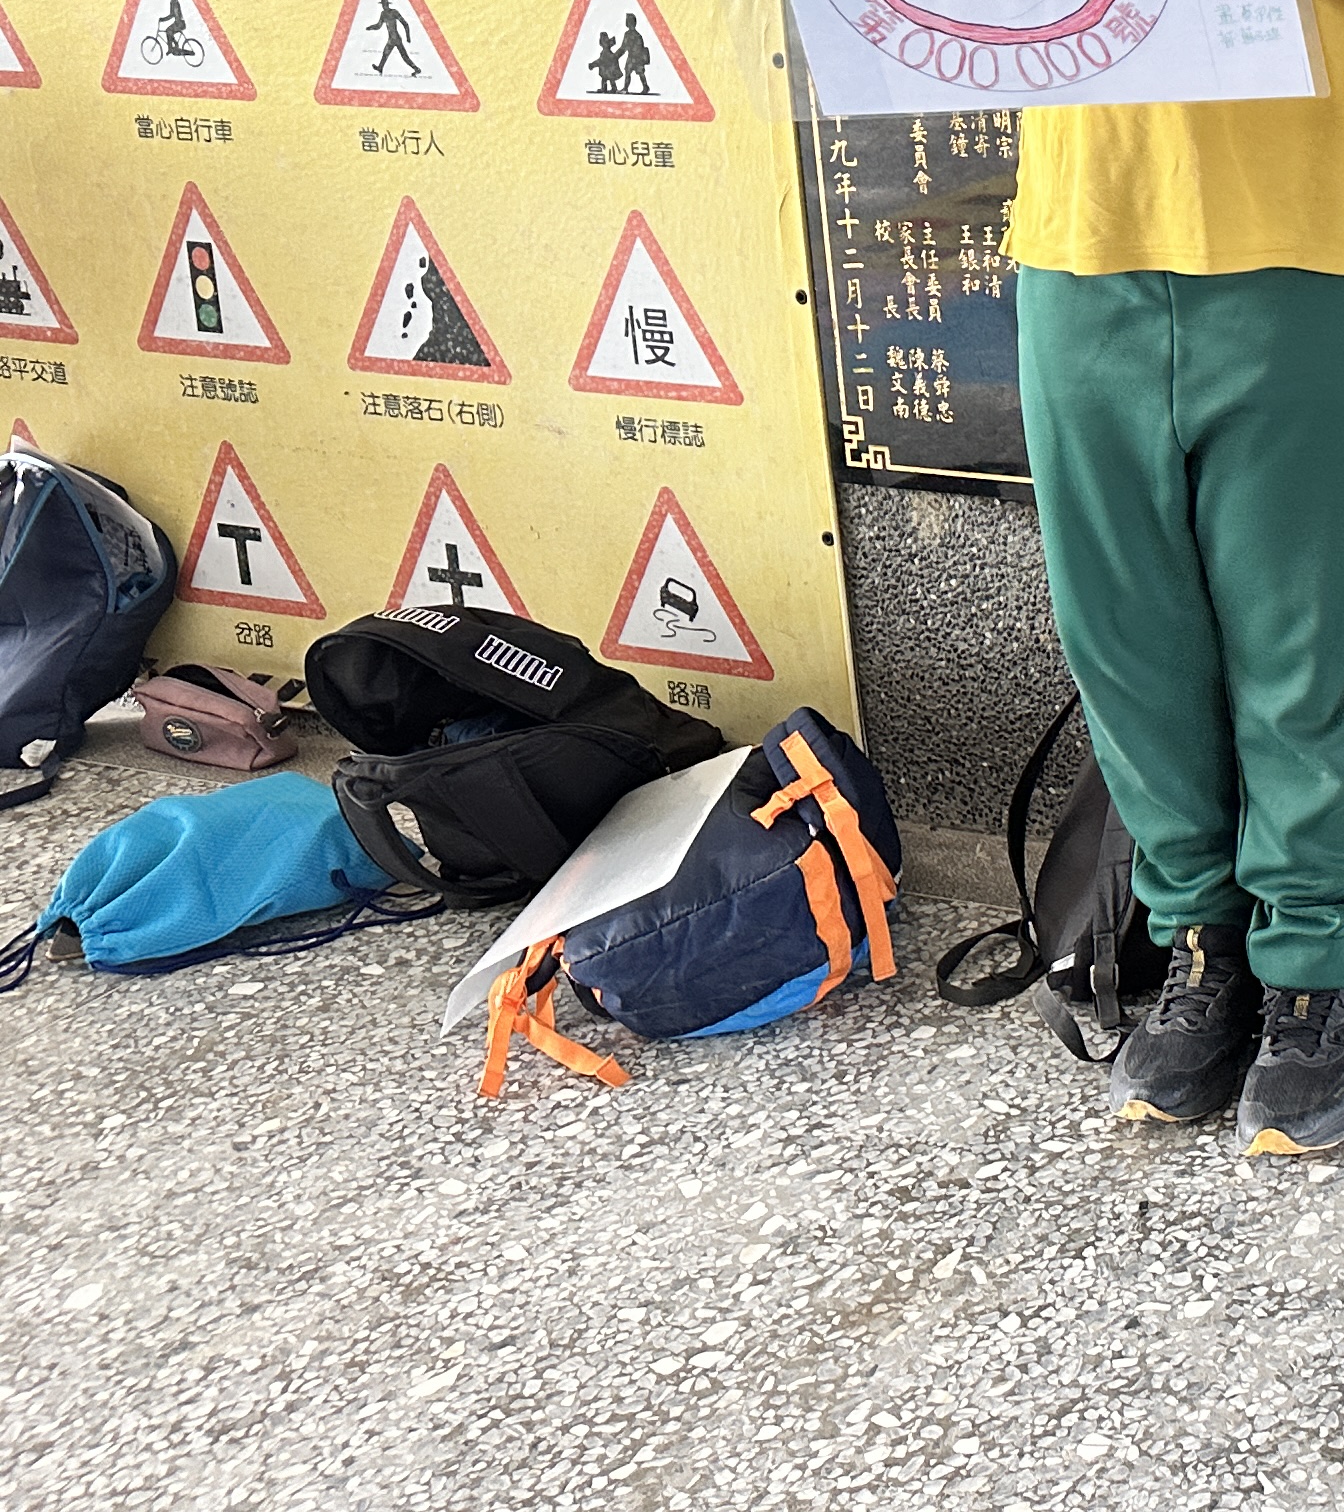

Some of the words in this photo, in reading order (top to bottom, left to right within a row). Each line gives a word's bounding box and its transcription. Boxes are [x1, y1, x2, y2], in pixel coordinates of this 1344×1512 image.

[135, 114, 234, 143] 當心自行車
[358, 127, 445, 157] 當心行人
[584, 139, 675, 169] 當心兒童
[921, 222, 942, 323] 主任委員
[624, 305, 677, 369] 慢
[179, 374, 259, 404] 注意號誌
[361, 391, 505, 429] 注意落石(右側)
[616, 416, 705, 449] 慢行標誌
[234, 622, 273, 649] 岔路
[475, 634, 563, 691] PUMA
[668, 682, 712, 711] 路滑
